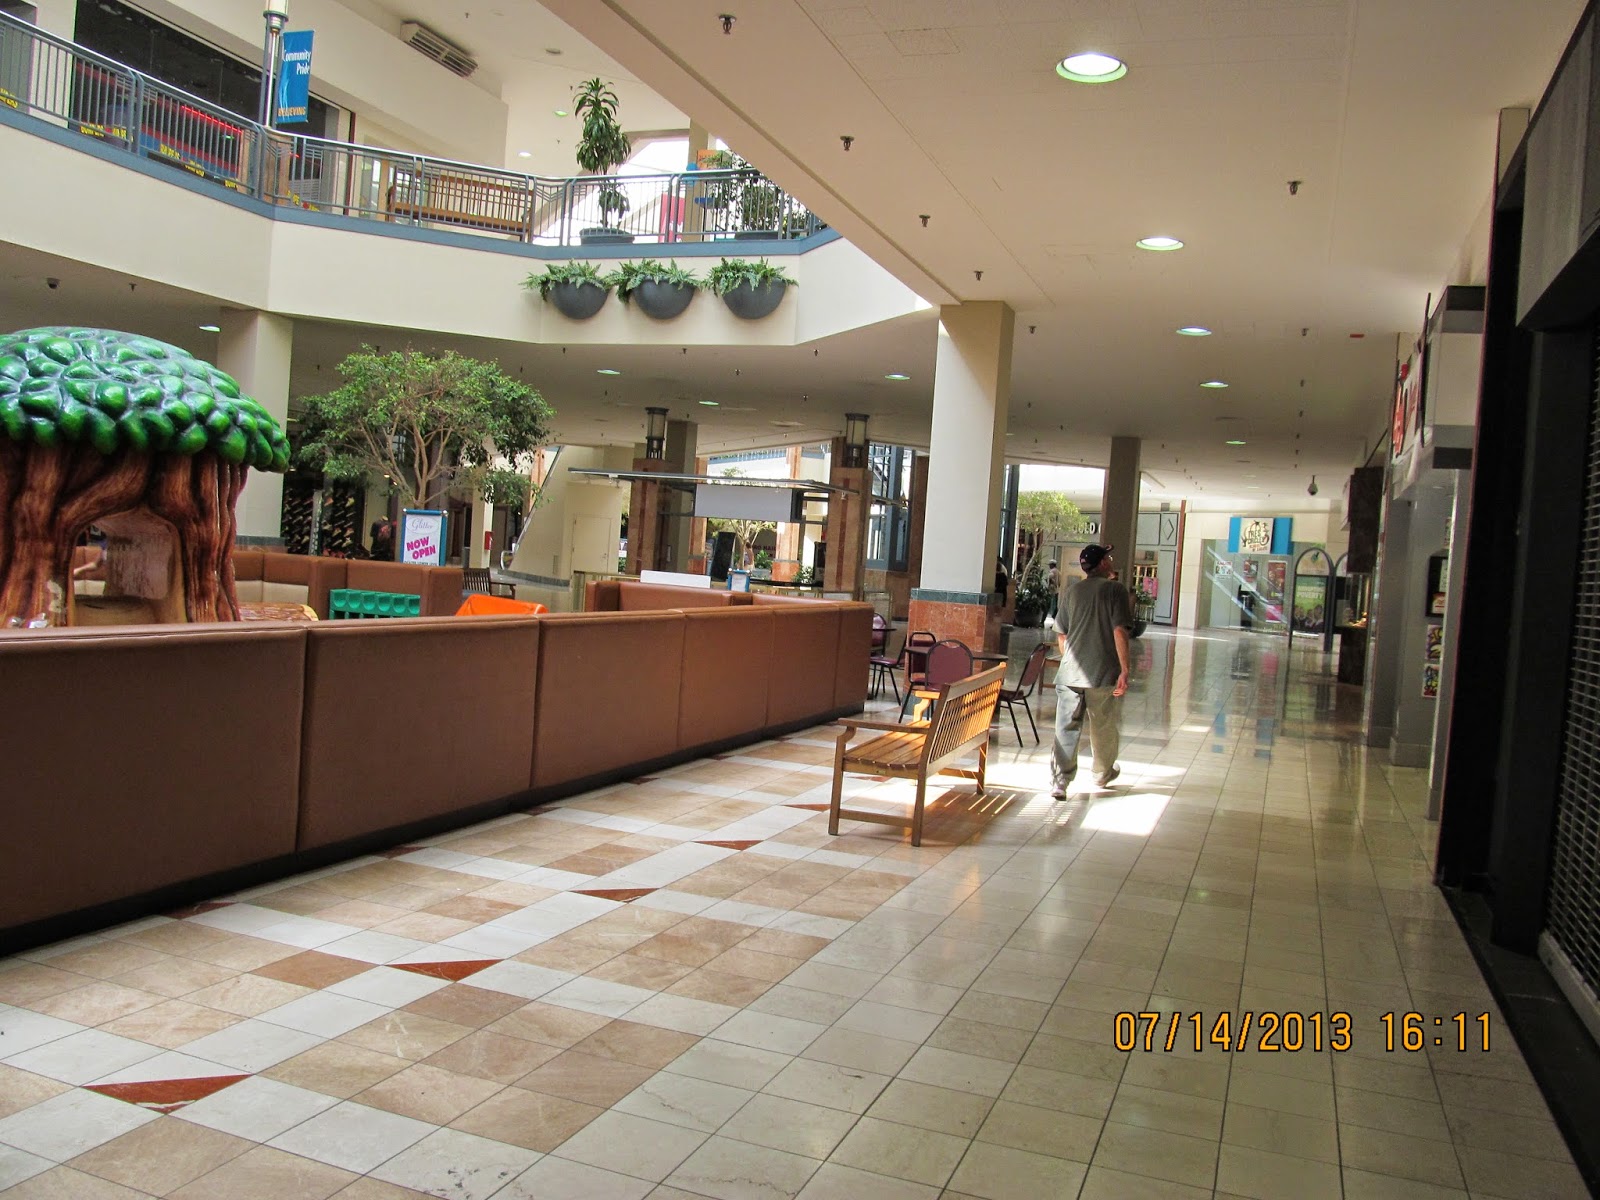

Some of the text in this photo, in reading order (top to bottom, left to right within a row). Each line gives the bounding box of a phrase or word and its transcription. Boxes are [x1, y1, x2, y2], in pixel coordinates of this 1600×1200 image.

[282, 48, 312, 63] Community
[296, 62, 311, 75] Pride
[406, 536, 430, 551] NOW
[412, 545, 437, 560] OPEN
